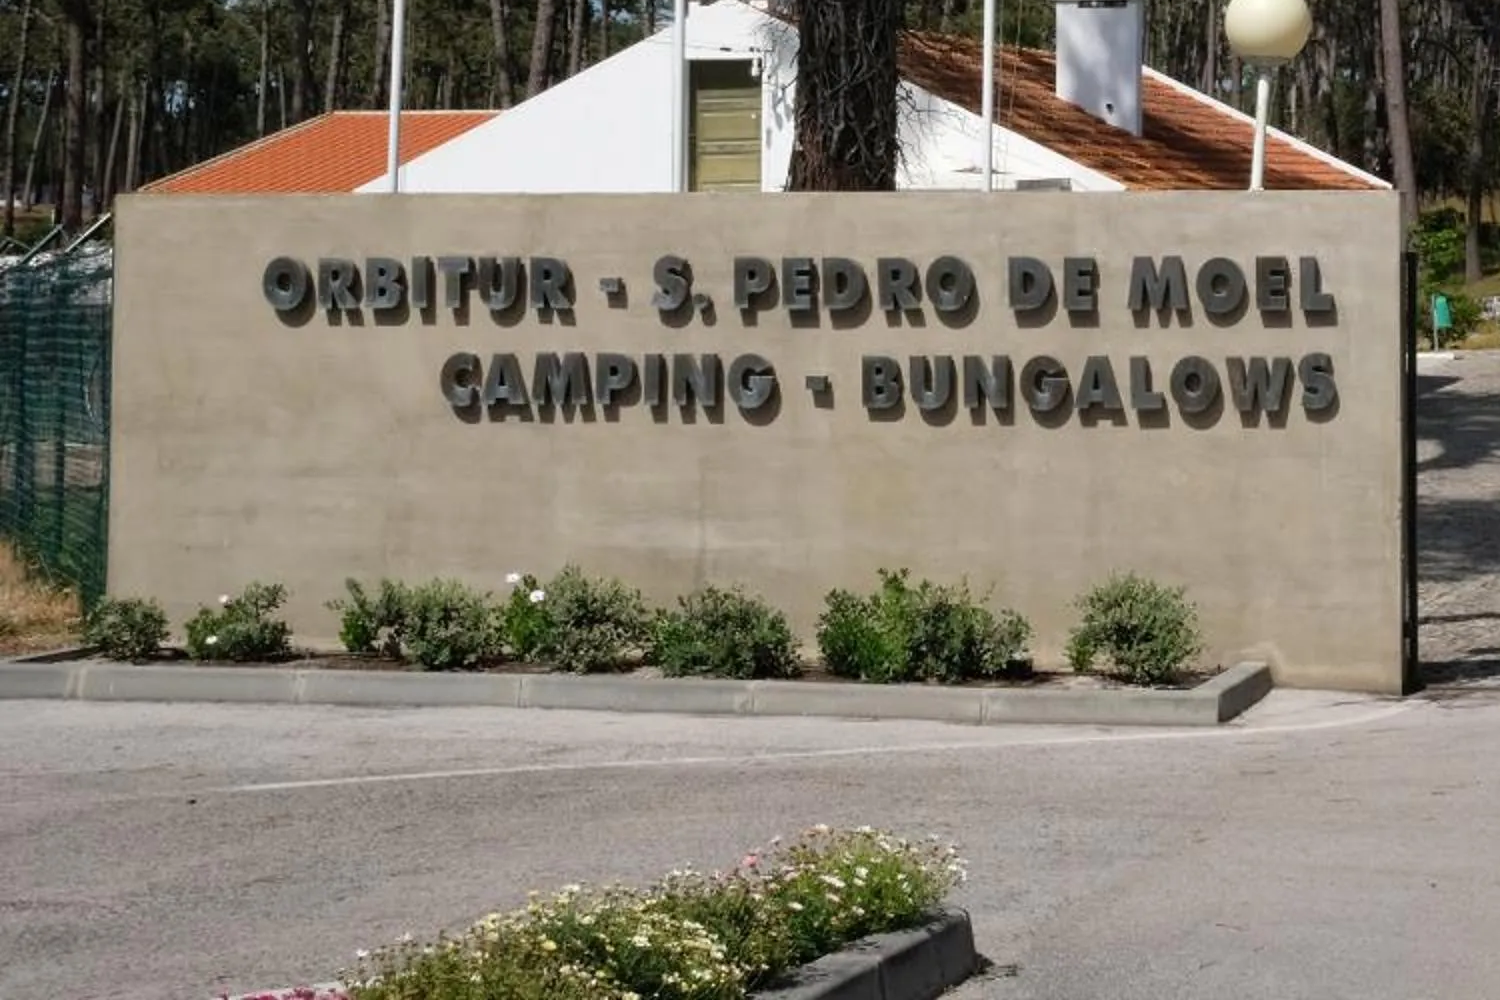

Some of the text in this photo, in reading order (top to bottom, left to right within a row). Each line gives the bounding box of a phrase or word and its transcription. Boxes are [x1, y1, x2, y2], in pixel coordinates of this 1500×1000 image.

[262, 255, 577, 315] ORBITUR
[733, 255, 975, 315] PEDRO
[1007, 255, 1099, 315] DE
[1127, 255, 1336, 315] MOEL
[440, 351, 777, 412] CAMPING
[861, 352, 1337, 414] BUNGALOWS
